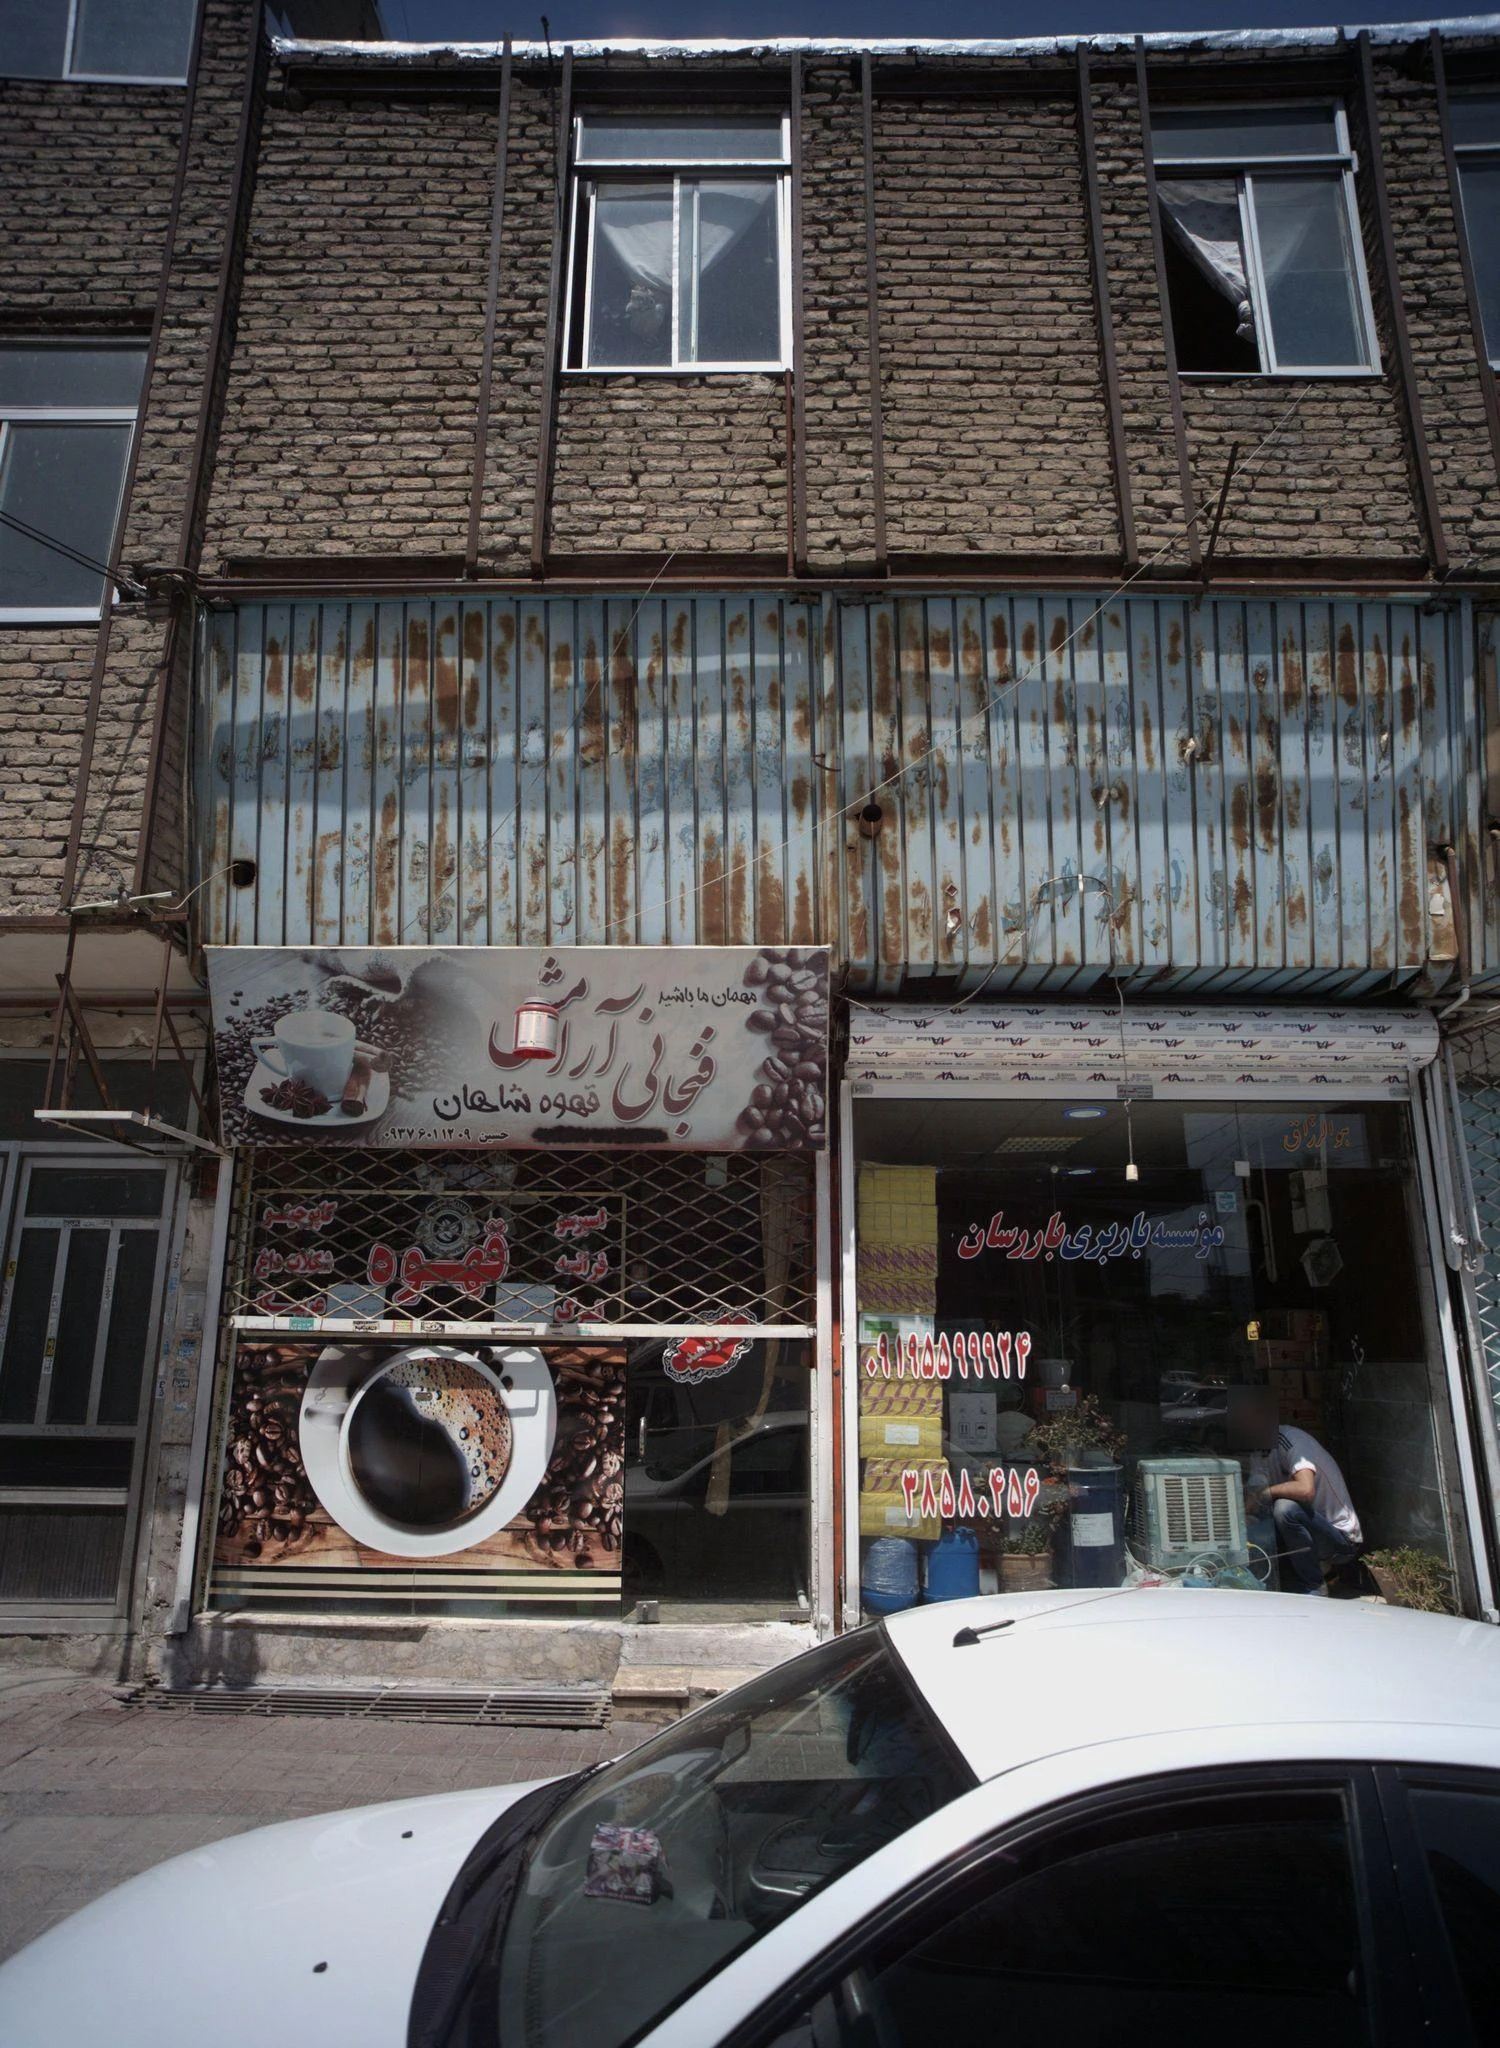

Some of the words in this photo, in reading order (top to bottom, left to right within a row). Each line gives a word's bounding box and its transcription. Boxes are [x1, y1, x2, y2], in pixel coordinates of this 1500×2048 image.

[658, 986, 694, 1007] باشید
[699, 986, 710, 1002] ما
[711, 986, 758, 1007] مهمان
[433, 1083, 532, 1121] شاهان
[539, 1083, 601, 1119] قهوه
[478, 1130, 510, 1144] حسین
[1060, 1210, 1150, 1265] باربری
[366, 1217, 511, 1307] قهوه
[866, 1331, 1032, 1380] ۰۹۱۹۵۵۹۹۹۲۴
[902, 1467, 1040, 1519] ۳۸۵۸۰۴۵۶
